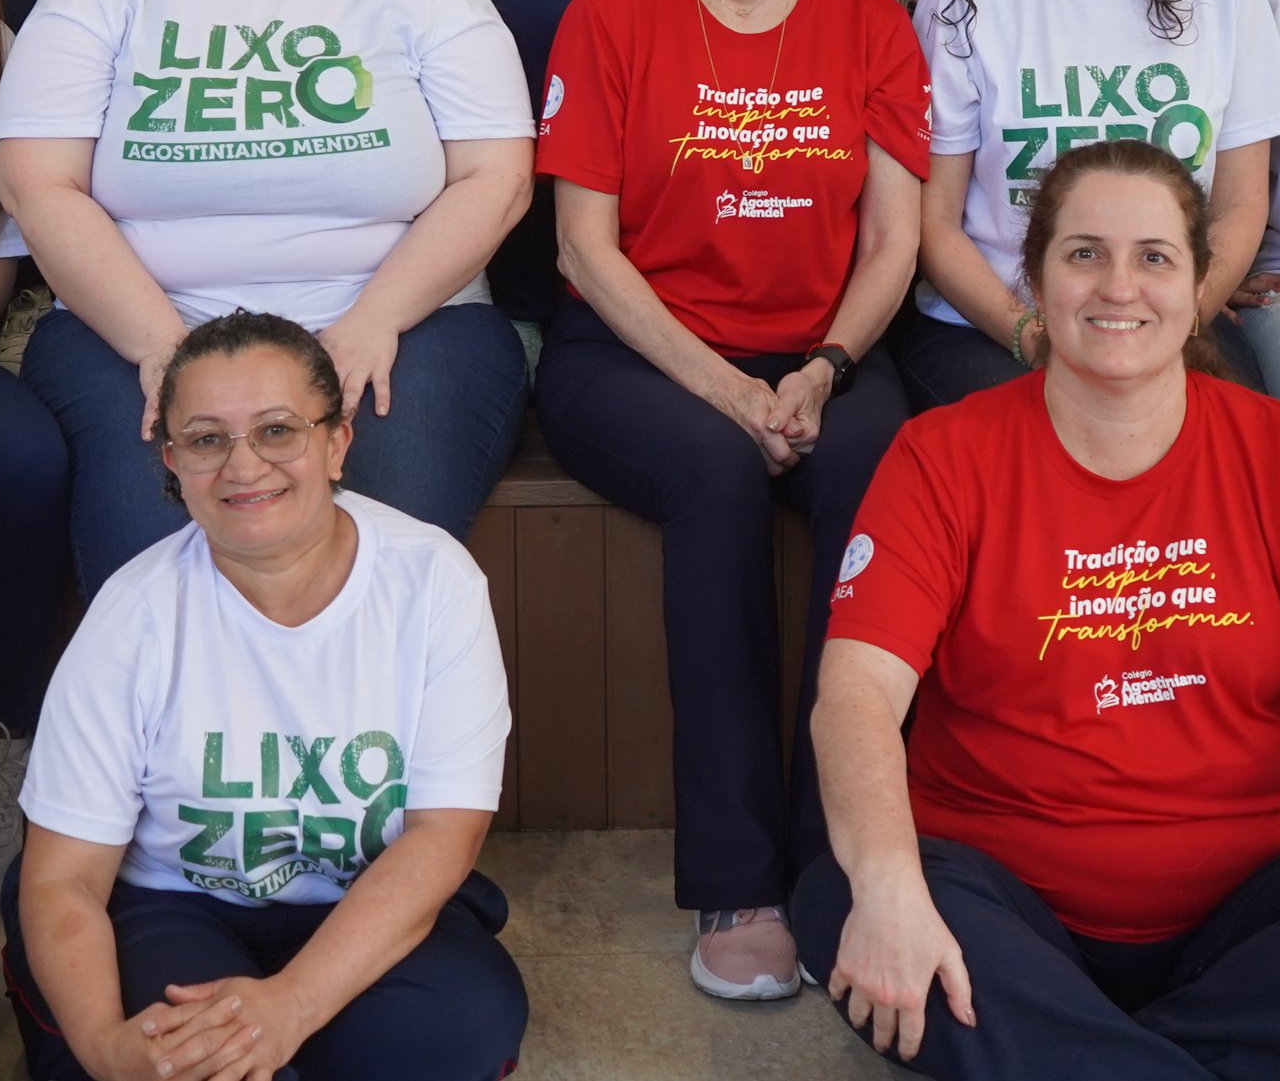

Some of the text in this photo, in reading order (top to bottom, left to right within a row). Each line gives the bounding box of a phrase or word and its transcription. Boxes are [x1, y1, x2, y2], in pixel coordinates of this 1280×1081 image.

[159, 19, 342, 72] LIXO
[127, 55, 375, 132] ZERO
[697, 84, 823, 110] Tradição que
[1020, 63, 1190, 119] LIXO
[693, 100, 830, 131] inspira,
[128, 132, 384, 161] AGOSTINIANO MENDEL
[697, 121, 830, 148] inovação que
[669, 133, 854, 176] Transforma.
[740, 196, 813, 209] Agostiniano
[742, 189, 768, 197] Colégio
[738, 207, 785, 218] Mendel
[1064, 538, 1207, 569] Tradição que
[1062, 561, 1216, 597] inspira,
[1070, 587, 1216, 619] inovação que
[1038, 606, 1254, 661] Transforma.
[1122, 670, 1152, 679] Colégio
[1122, 674, 1206, 694] Agostiniano
[1122, 689, 1175, 706] Mendel
[202, 731, 405, 804] LIXO
